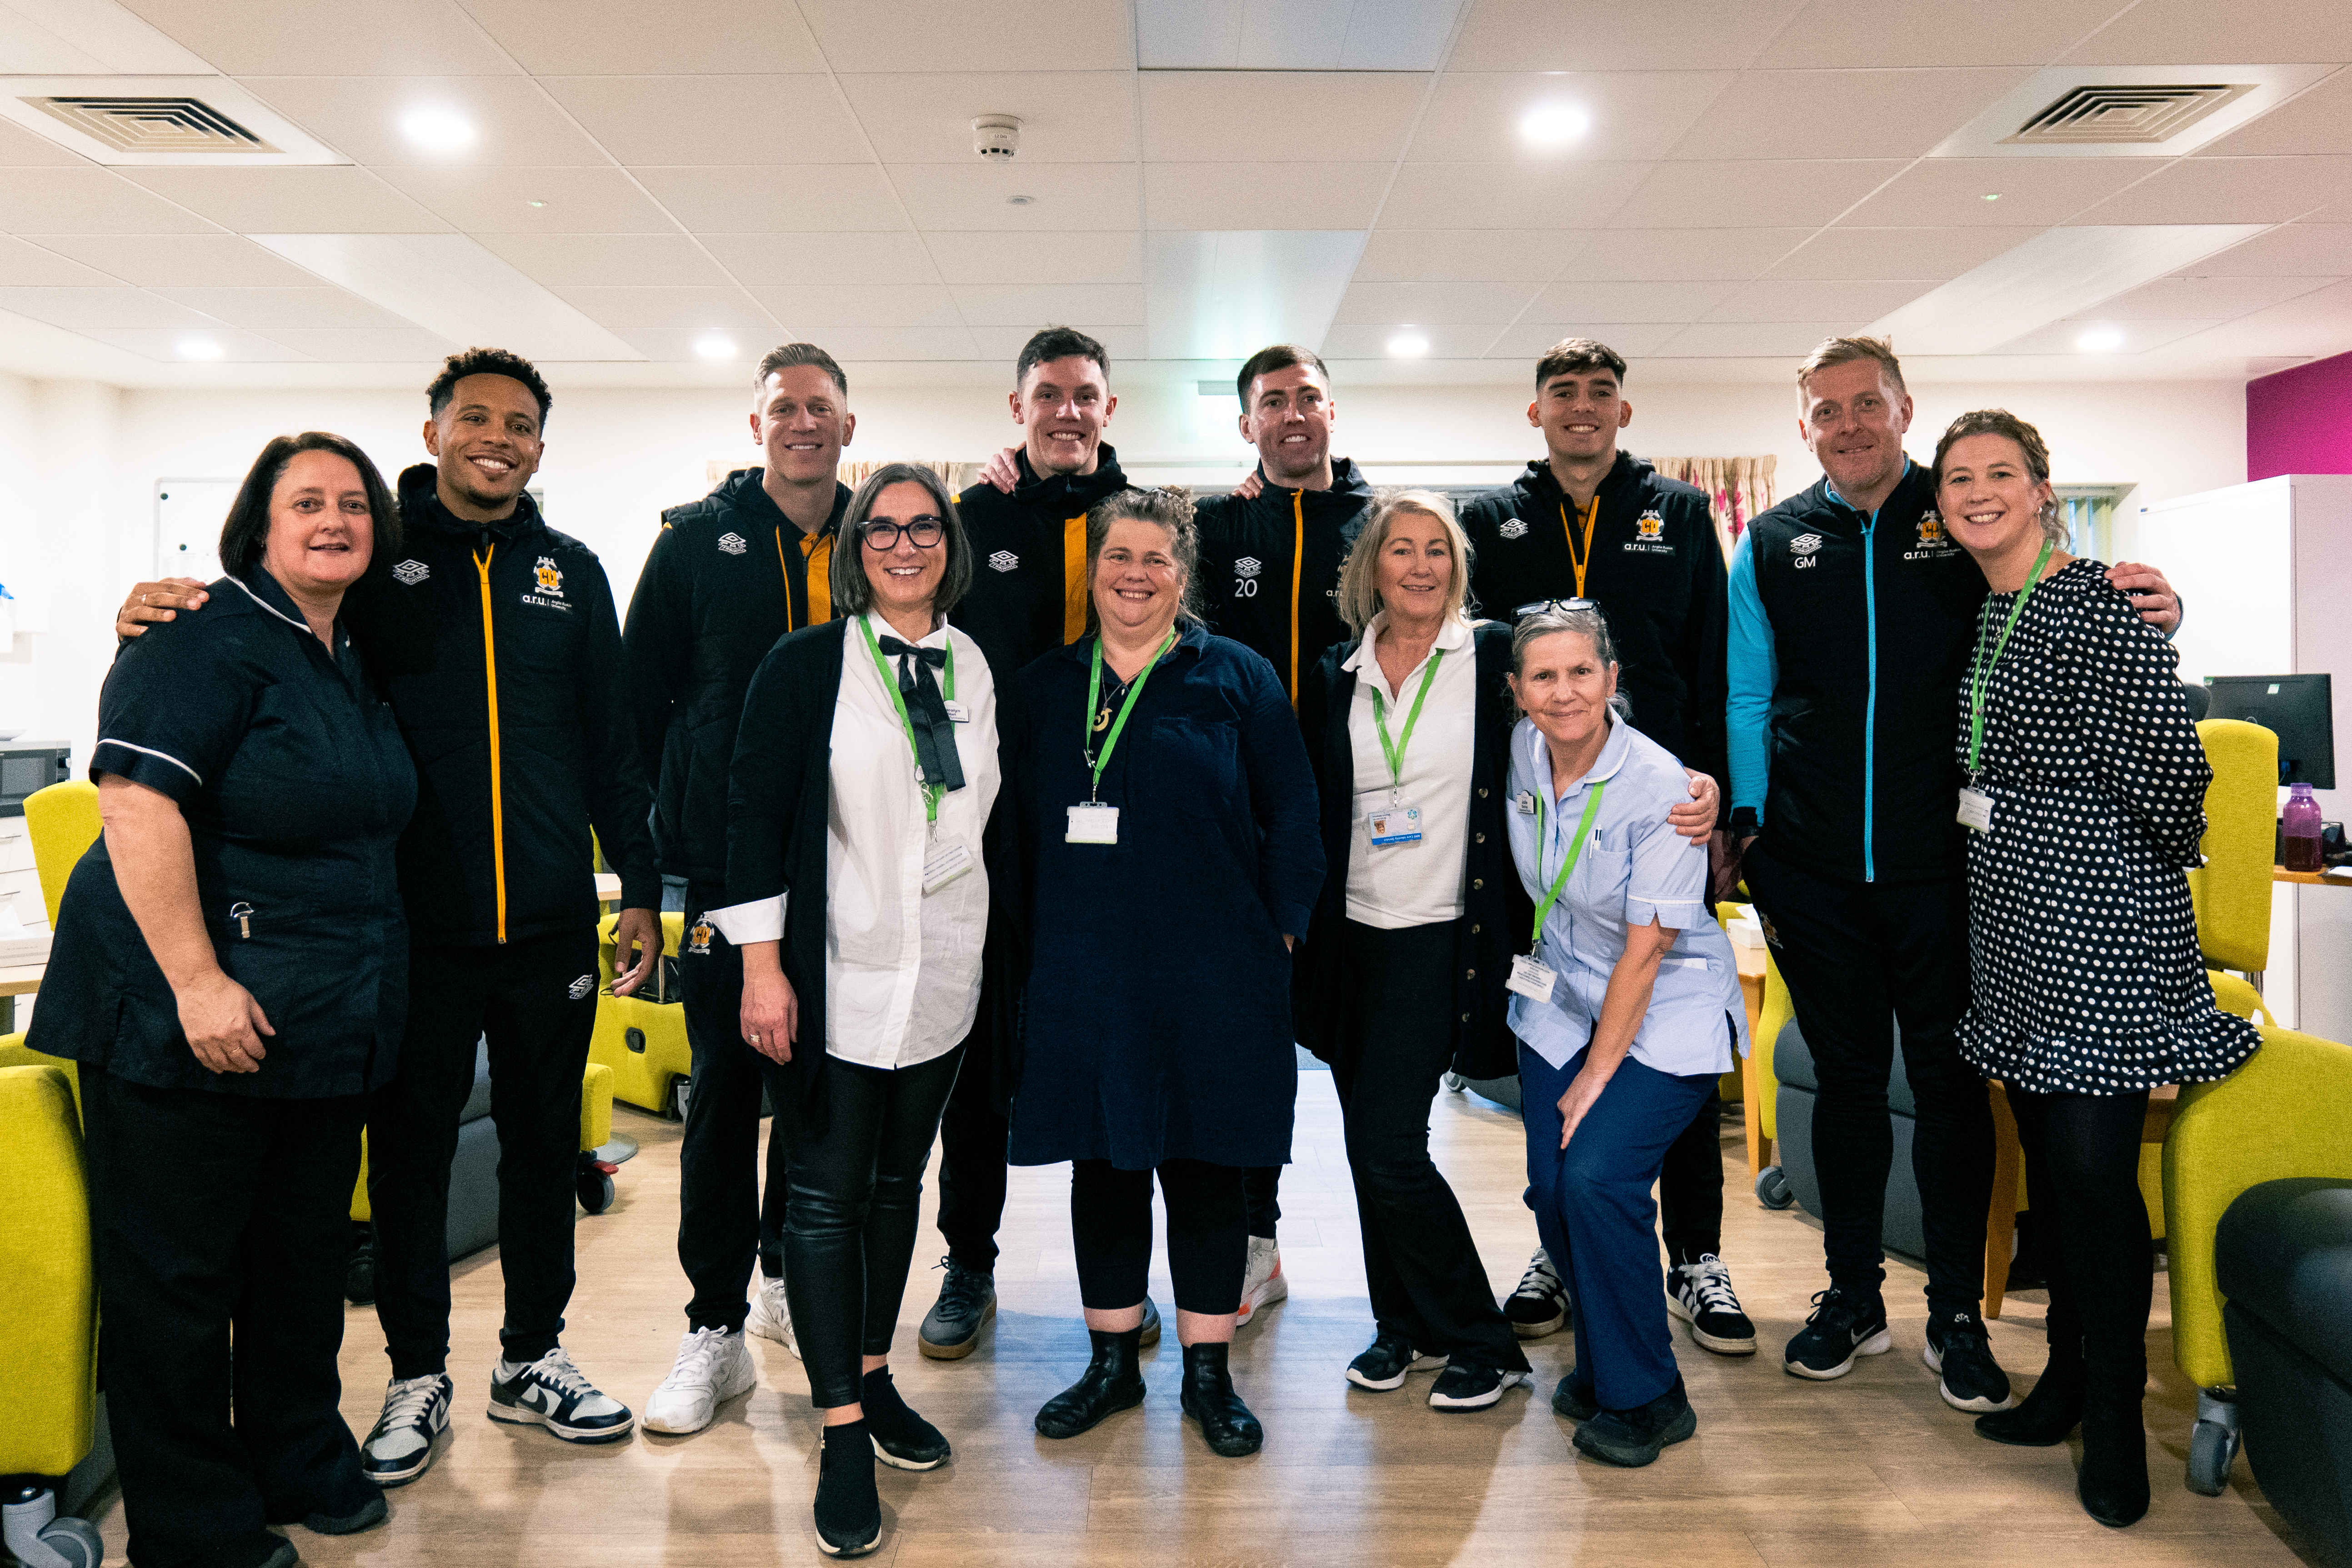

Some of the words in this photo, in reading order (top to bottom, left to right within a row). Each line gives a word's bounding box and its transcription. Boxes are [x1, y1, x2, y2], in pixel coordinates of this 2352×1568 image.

[1641, 519, 1659, 533] CU
[1795, 556, 1816, 568] GM
[1904, 551, 1930, 559] a.r.u.
[538, 567, 557, 586] CU
[1235, 578, 1258, 597] 20
[522, 595, 547, 606] a.r.u.
[693, 926, 711, 944] CU
